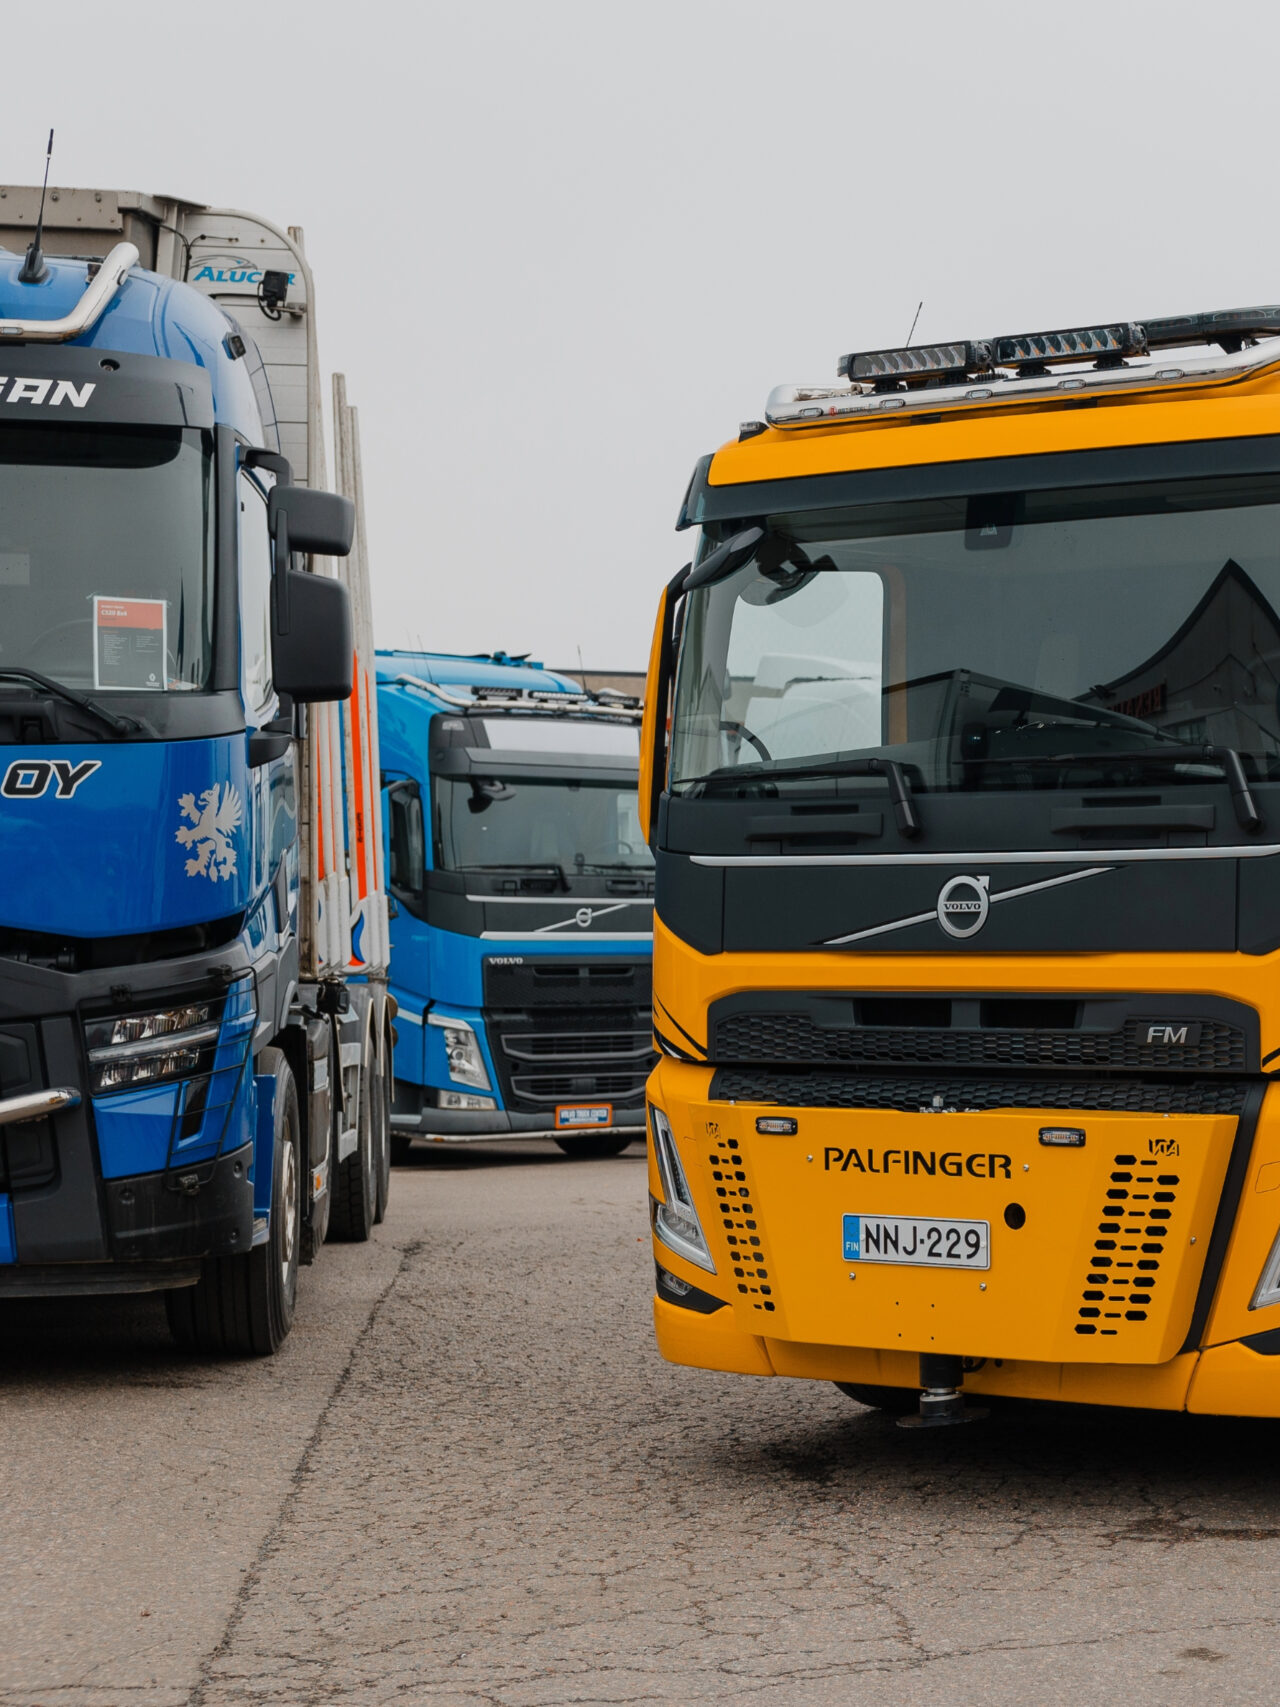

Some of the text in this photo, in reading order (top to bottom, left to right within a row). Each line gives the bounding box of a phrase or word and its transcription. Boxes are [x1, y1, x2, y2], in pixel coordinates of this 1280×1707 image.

[193, 266, 296, 286] ALUCR
[0, 376, 97, 408] AN
[1, 760, 102, 798] OY
[943, 902, 981, 910] VOLVO
[488, 957, 523, 965] VOLVO
[1146, 1026, 1188, 1043] FM
[823, 1146, 1012, 1179] PALFINGER
[845, 1241, 859, 1251] FIN
[864, 1223, 981, 1260] NNJ-229
